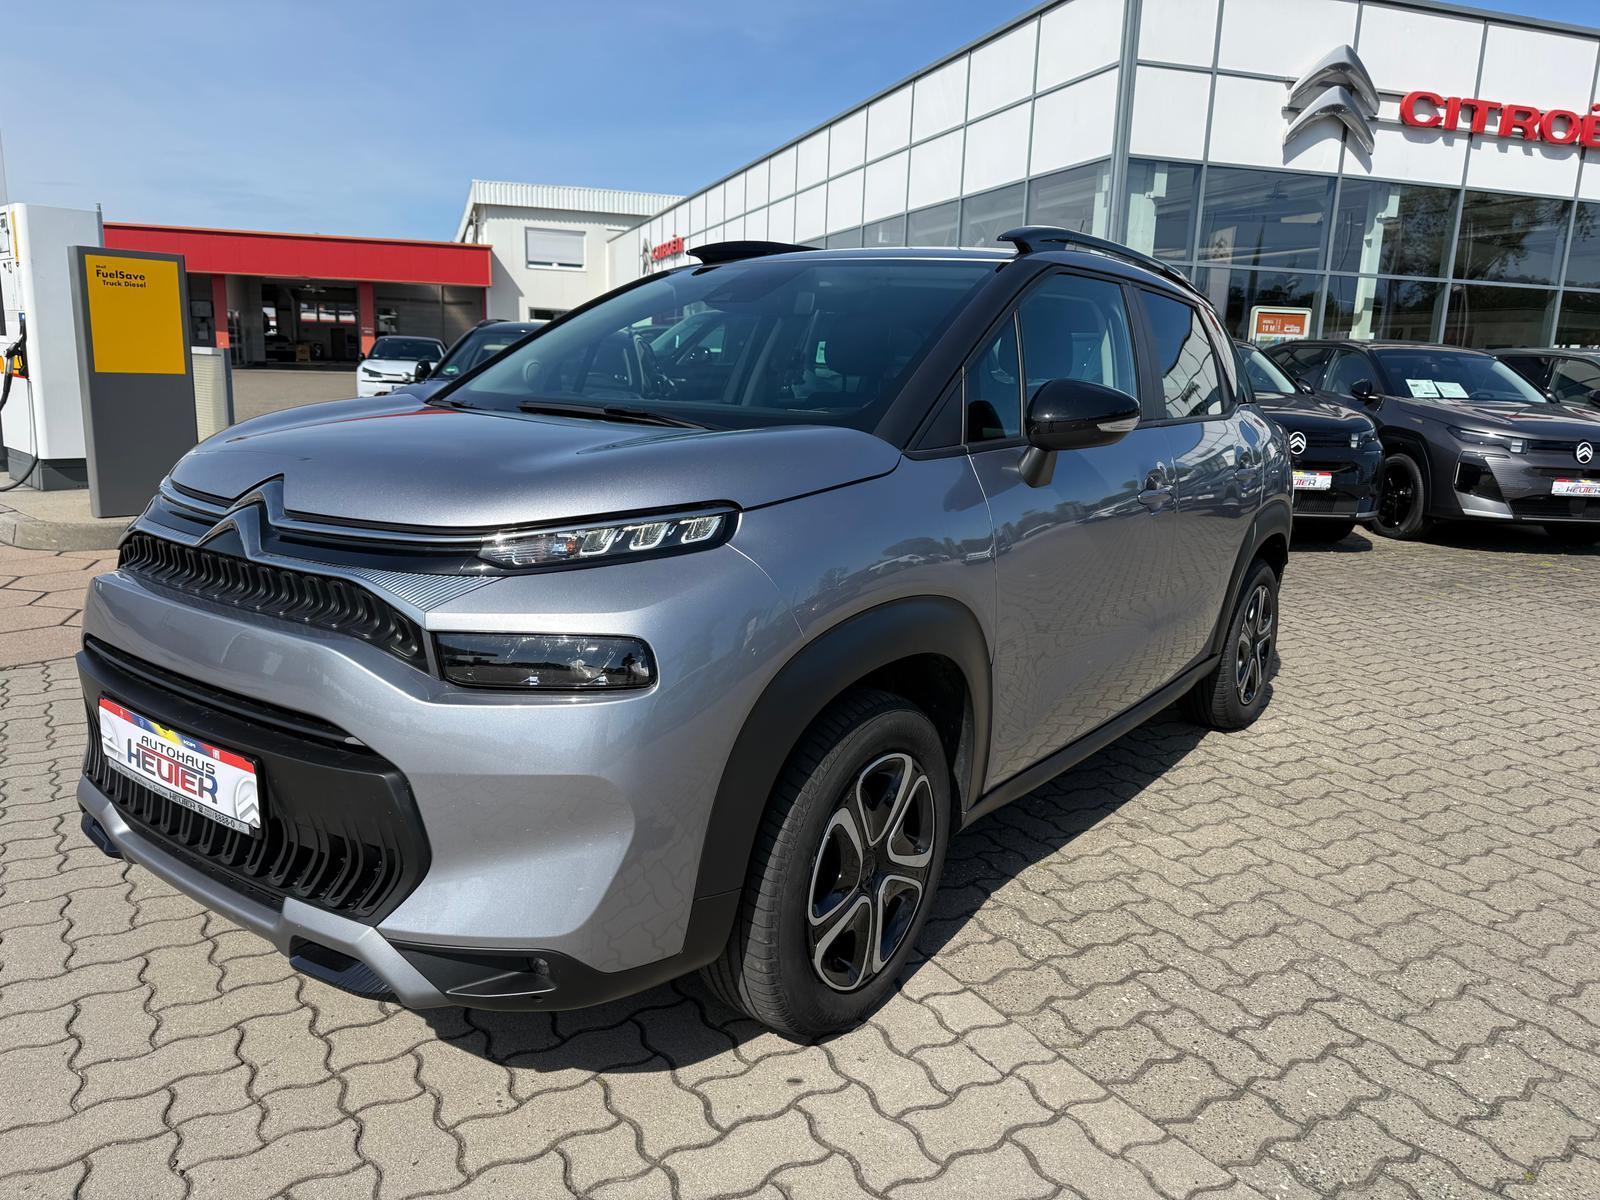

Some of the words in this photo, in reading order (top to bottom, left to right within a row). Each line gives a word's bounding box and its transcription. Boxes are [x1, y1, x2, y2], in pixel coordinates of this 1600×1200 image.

[96, 269, 146, 280] FuelSave
[127, 738, 218, 805] HEUTER
[141, 735, 216, 775] AUTOHAUS
